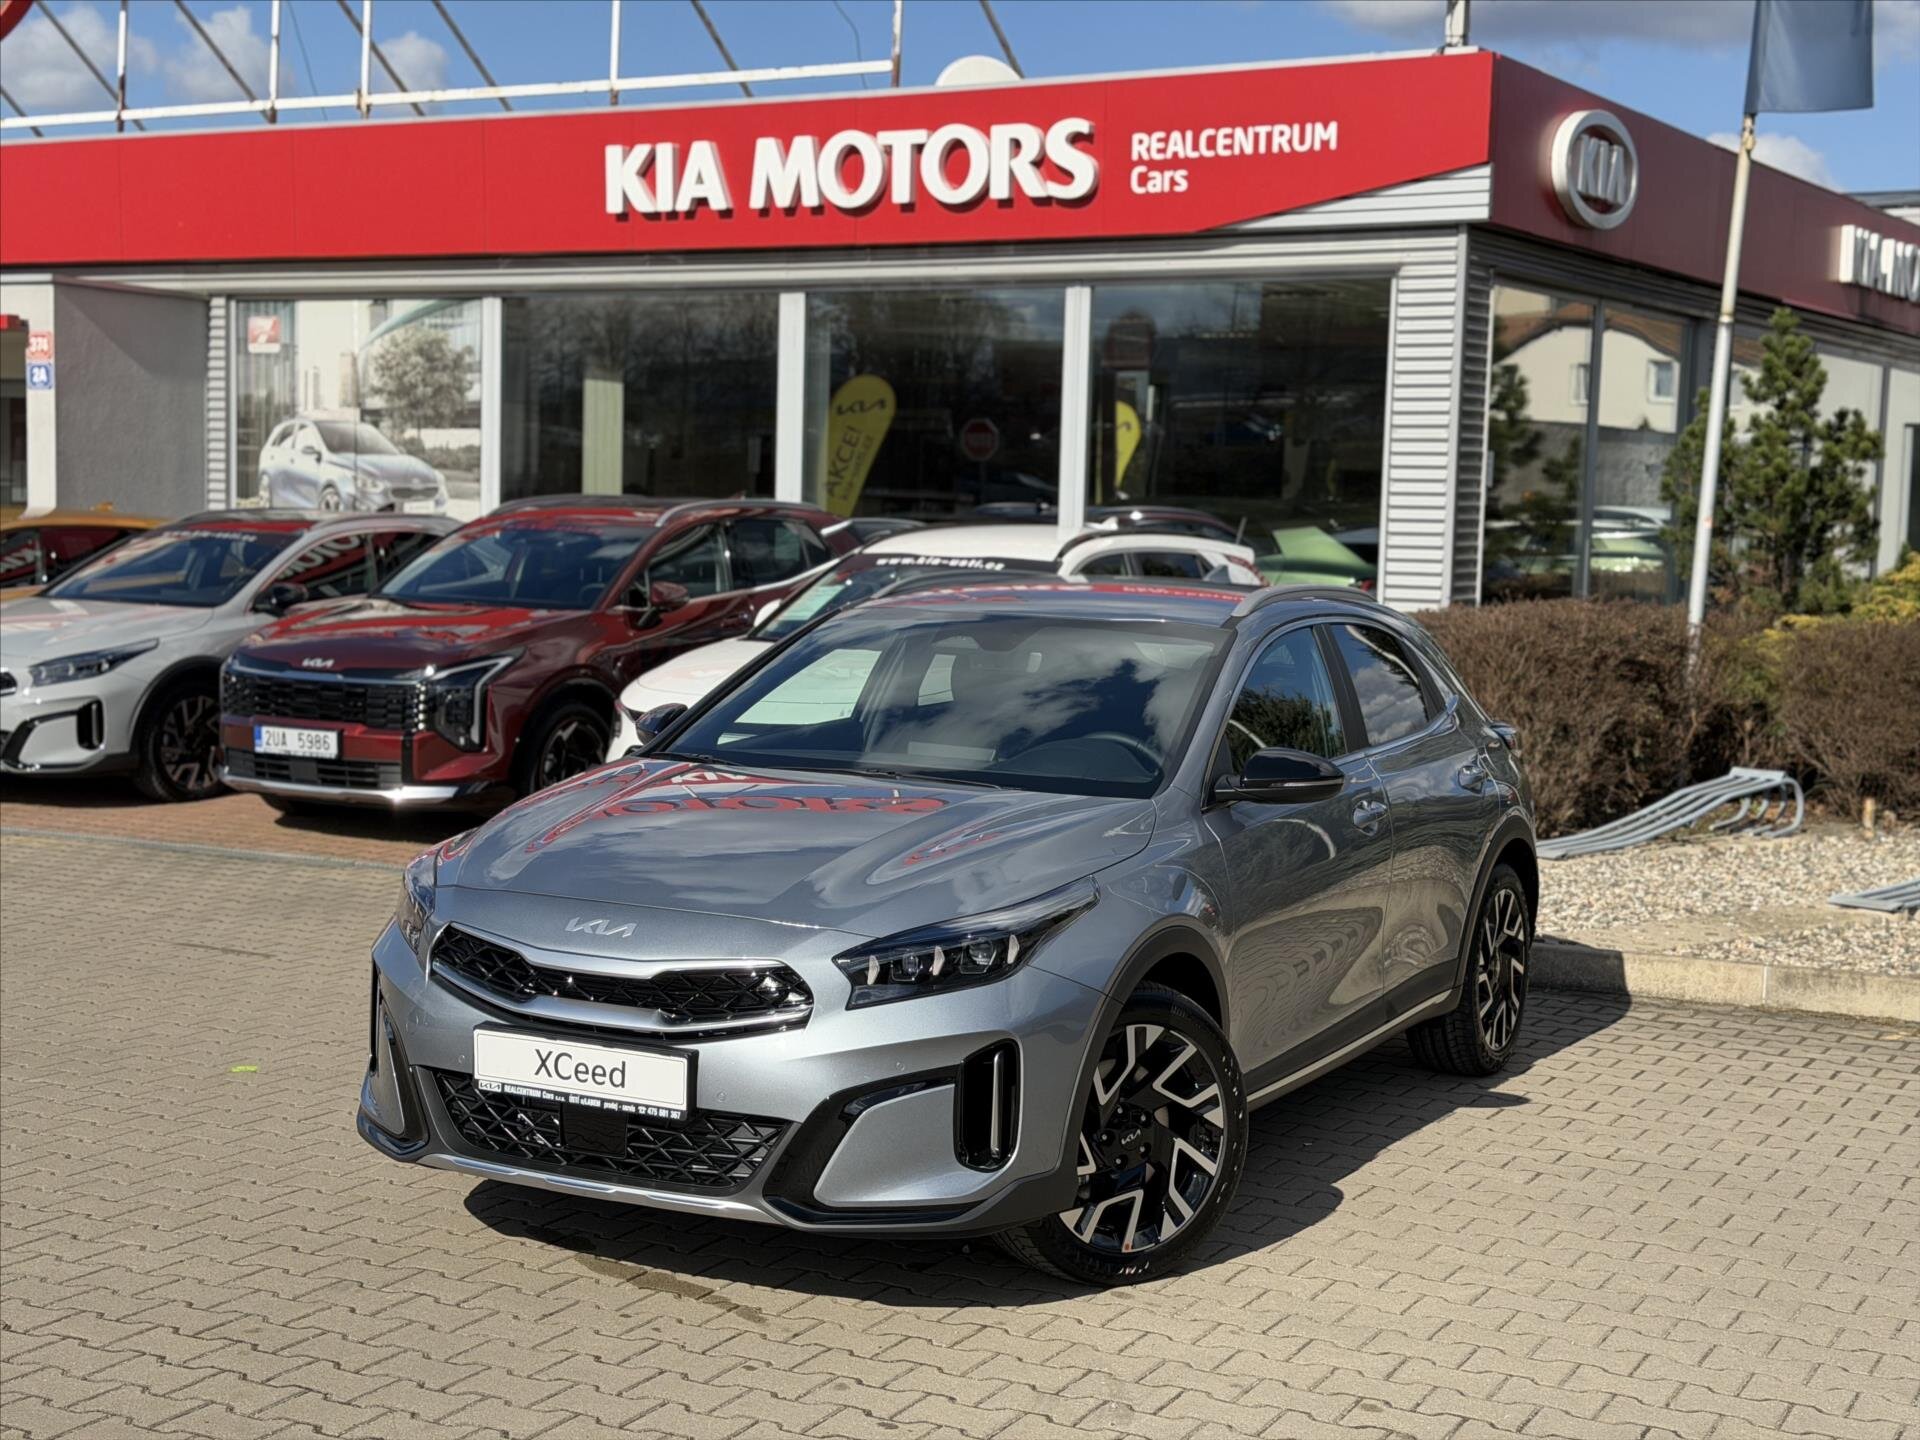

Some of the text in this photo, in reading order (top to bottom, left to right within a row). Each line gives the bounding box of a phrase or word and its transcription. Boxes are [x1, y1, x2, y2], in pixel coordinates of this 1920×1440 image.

[1131, 121, 1338, 162] REALCENTRUM
[605, 117, 1098, 214] KIA MOTORS
[1130, 165, 1189, 194] Cars
[264, 729, 331, 752] 2UA 5986
[534, 1048, 626, 1089] XCeed
